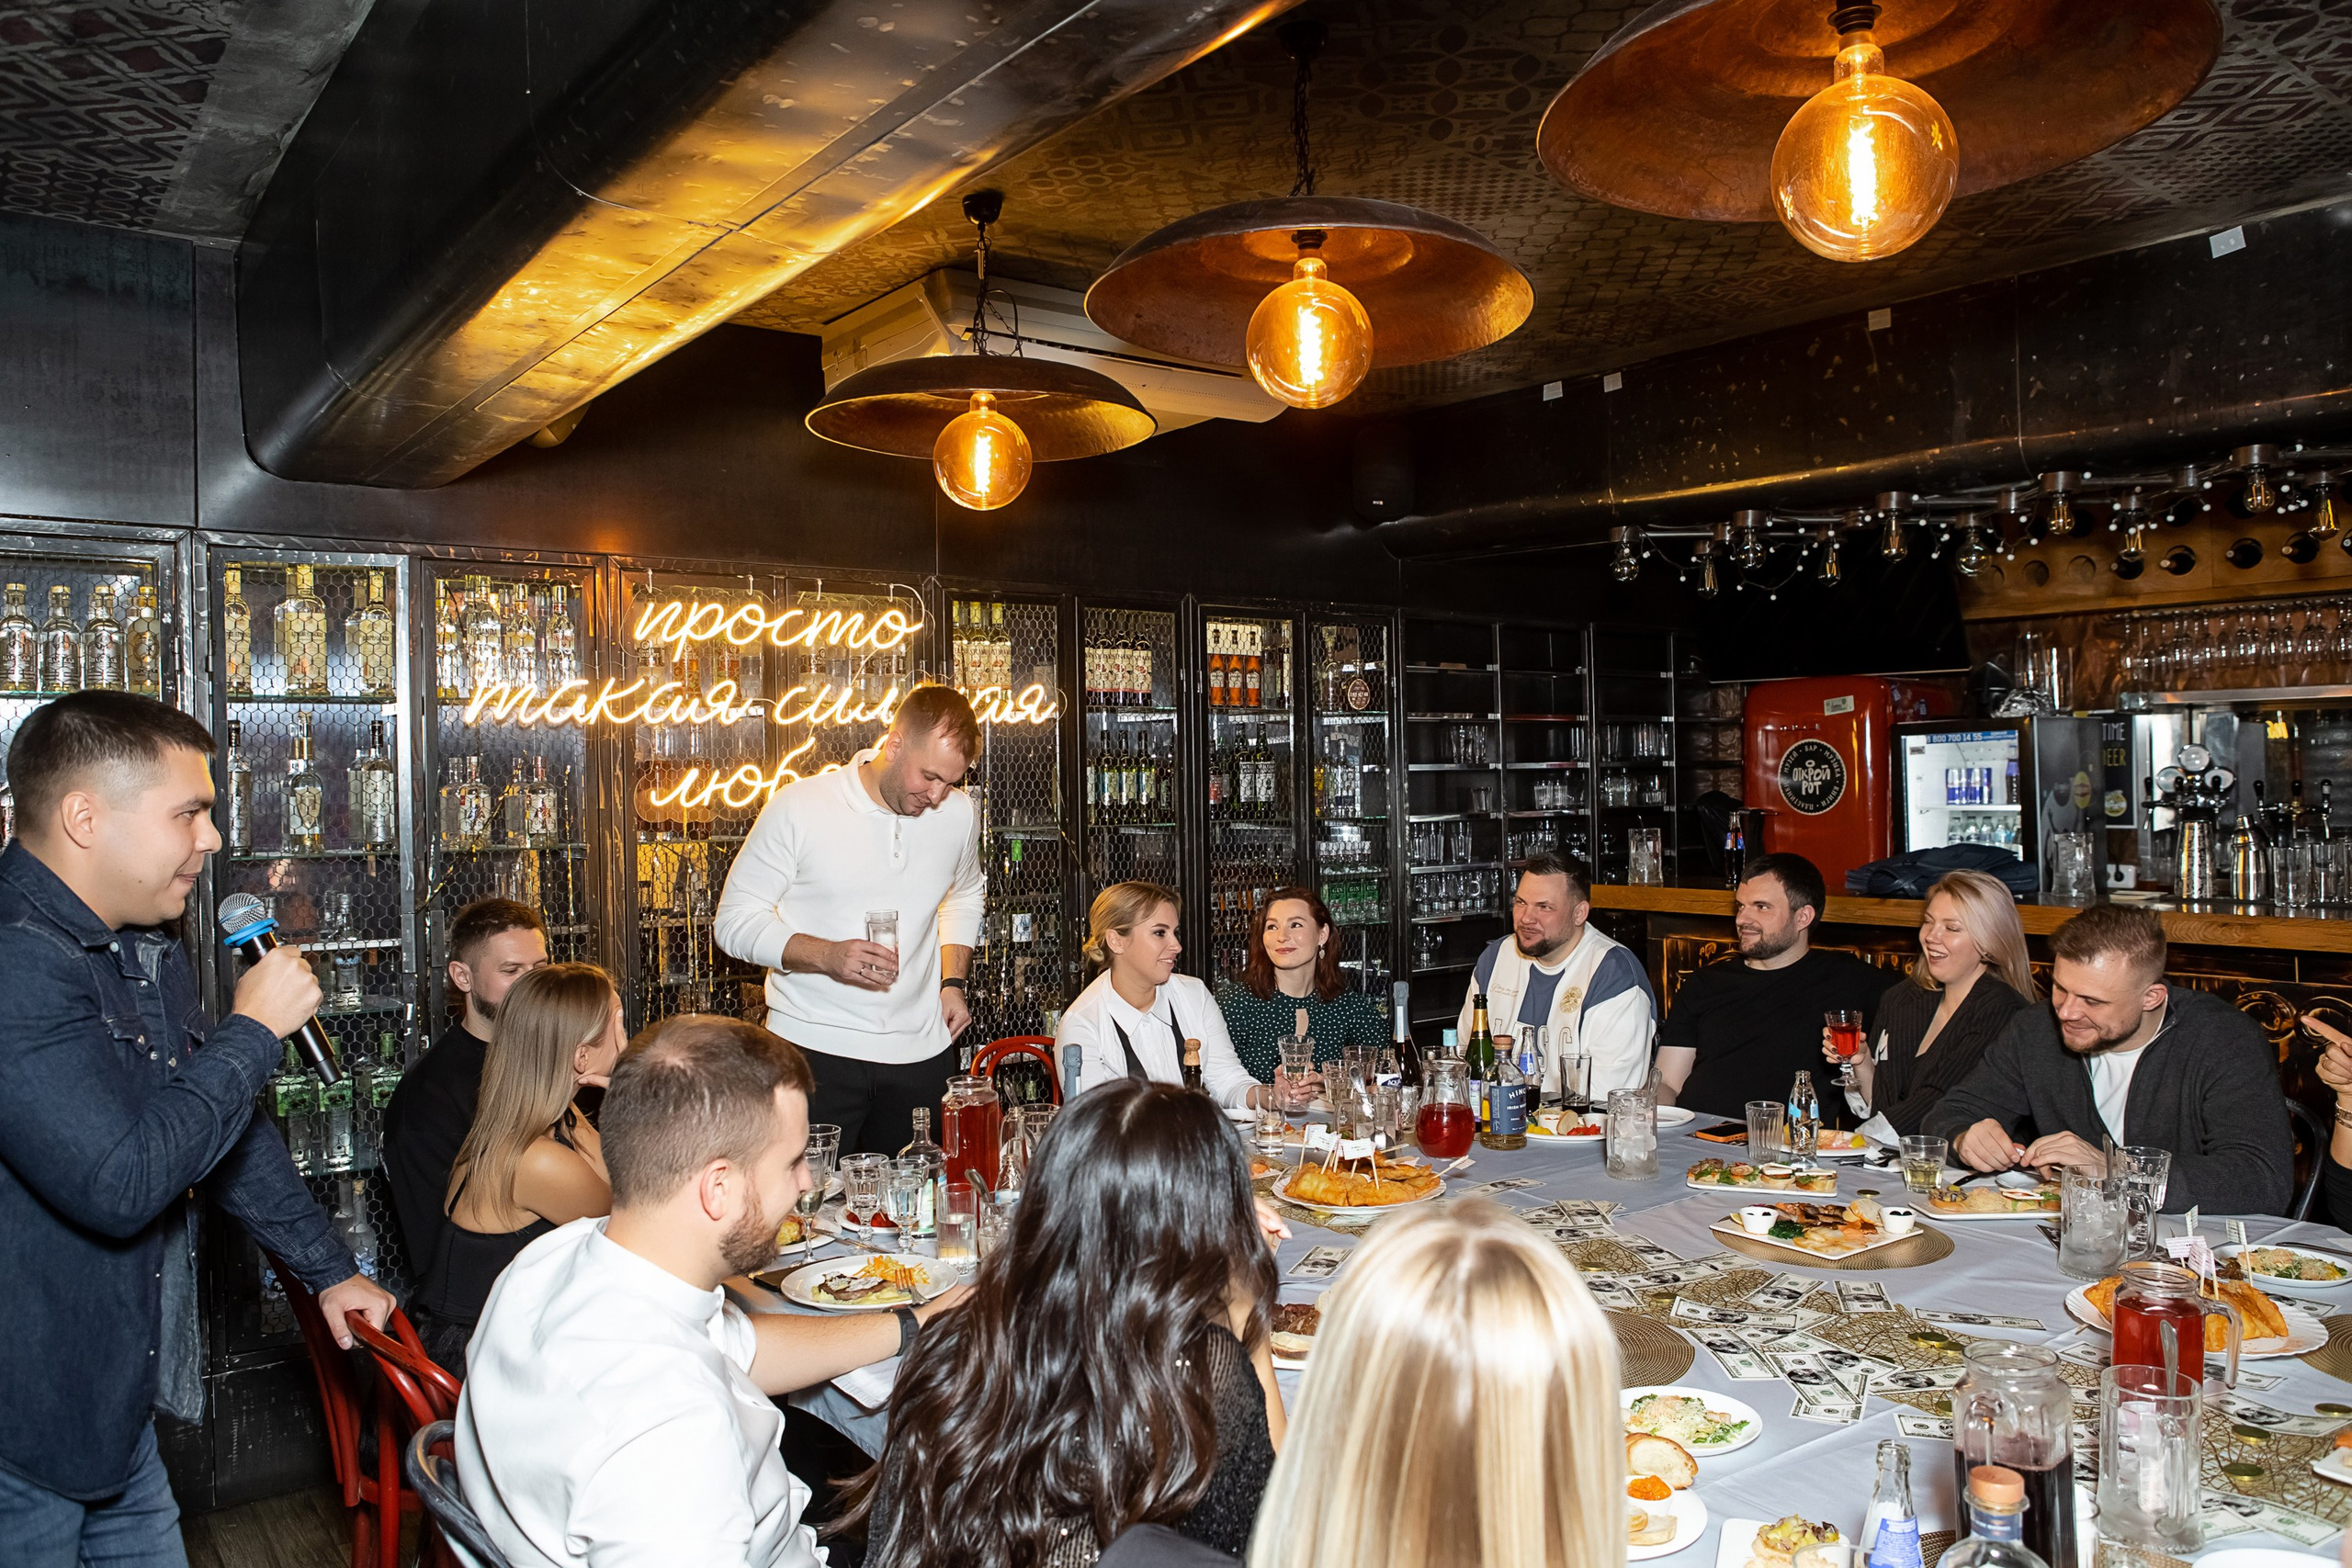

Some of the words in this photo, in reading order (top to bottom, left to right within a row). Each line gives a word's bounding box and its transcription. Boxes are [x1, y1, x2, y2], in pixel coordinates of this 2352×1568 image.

[634, 600, 924, 662] просто
[464, 676, 752, 726] такая
[775, 682, 1057, 726] силая
[1932, 735, 1947, 743] 800
[1948, 734, 1962, 742] 700
[1962, 733, 1971, 741] 14
[1973, 732, 1983, 740] 55
[2102, 722, 2126, 741] TIME
[2103, 748, 2127, 766] EER
[650, 735, 888, 808] люб
[1792, 764, 1831, 782] ОТКРОЙ
[1802, 781, 1823, 795] РОТ
